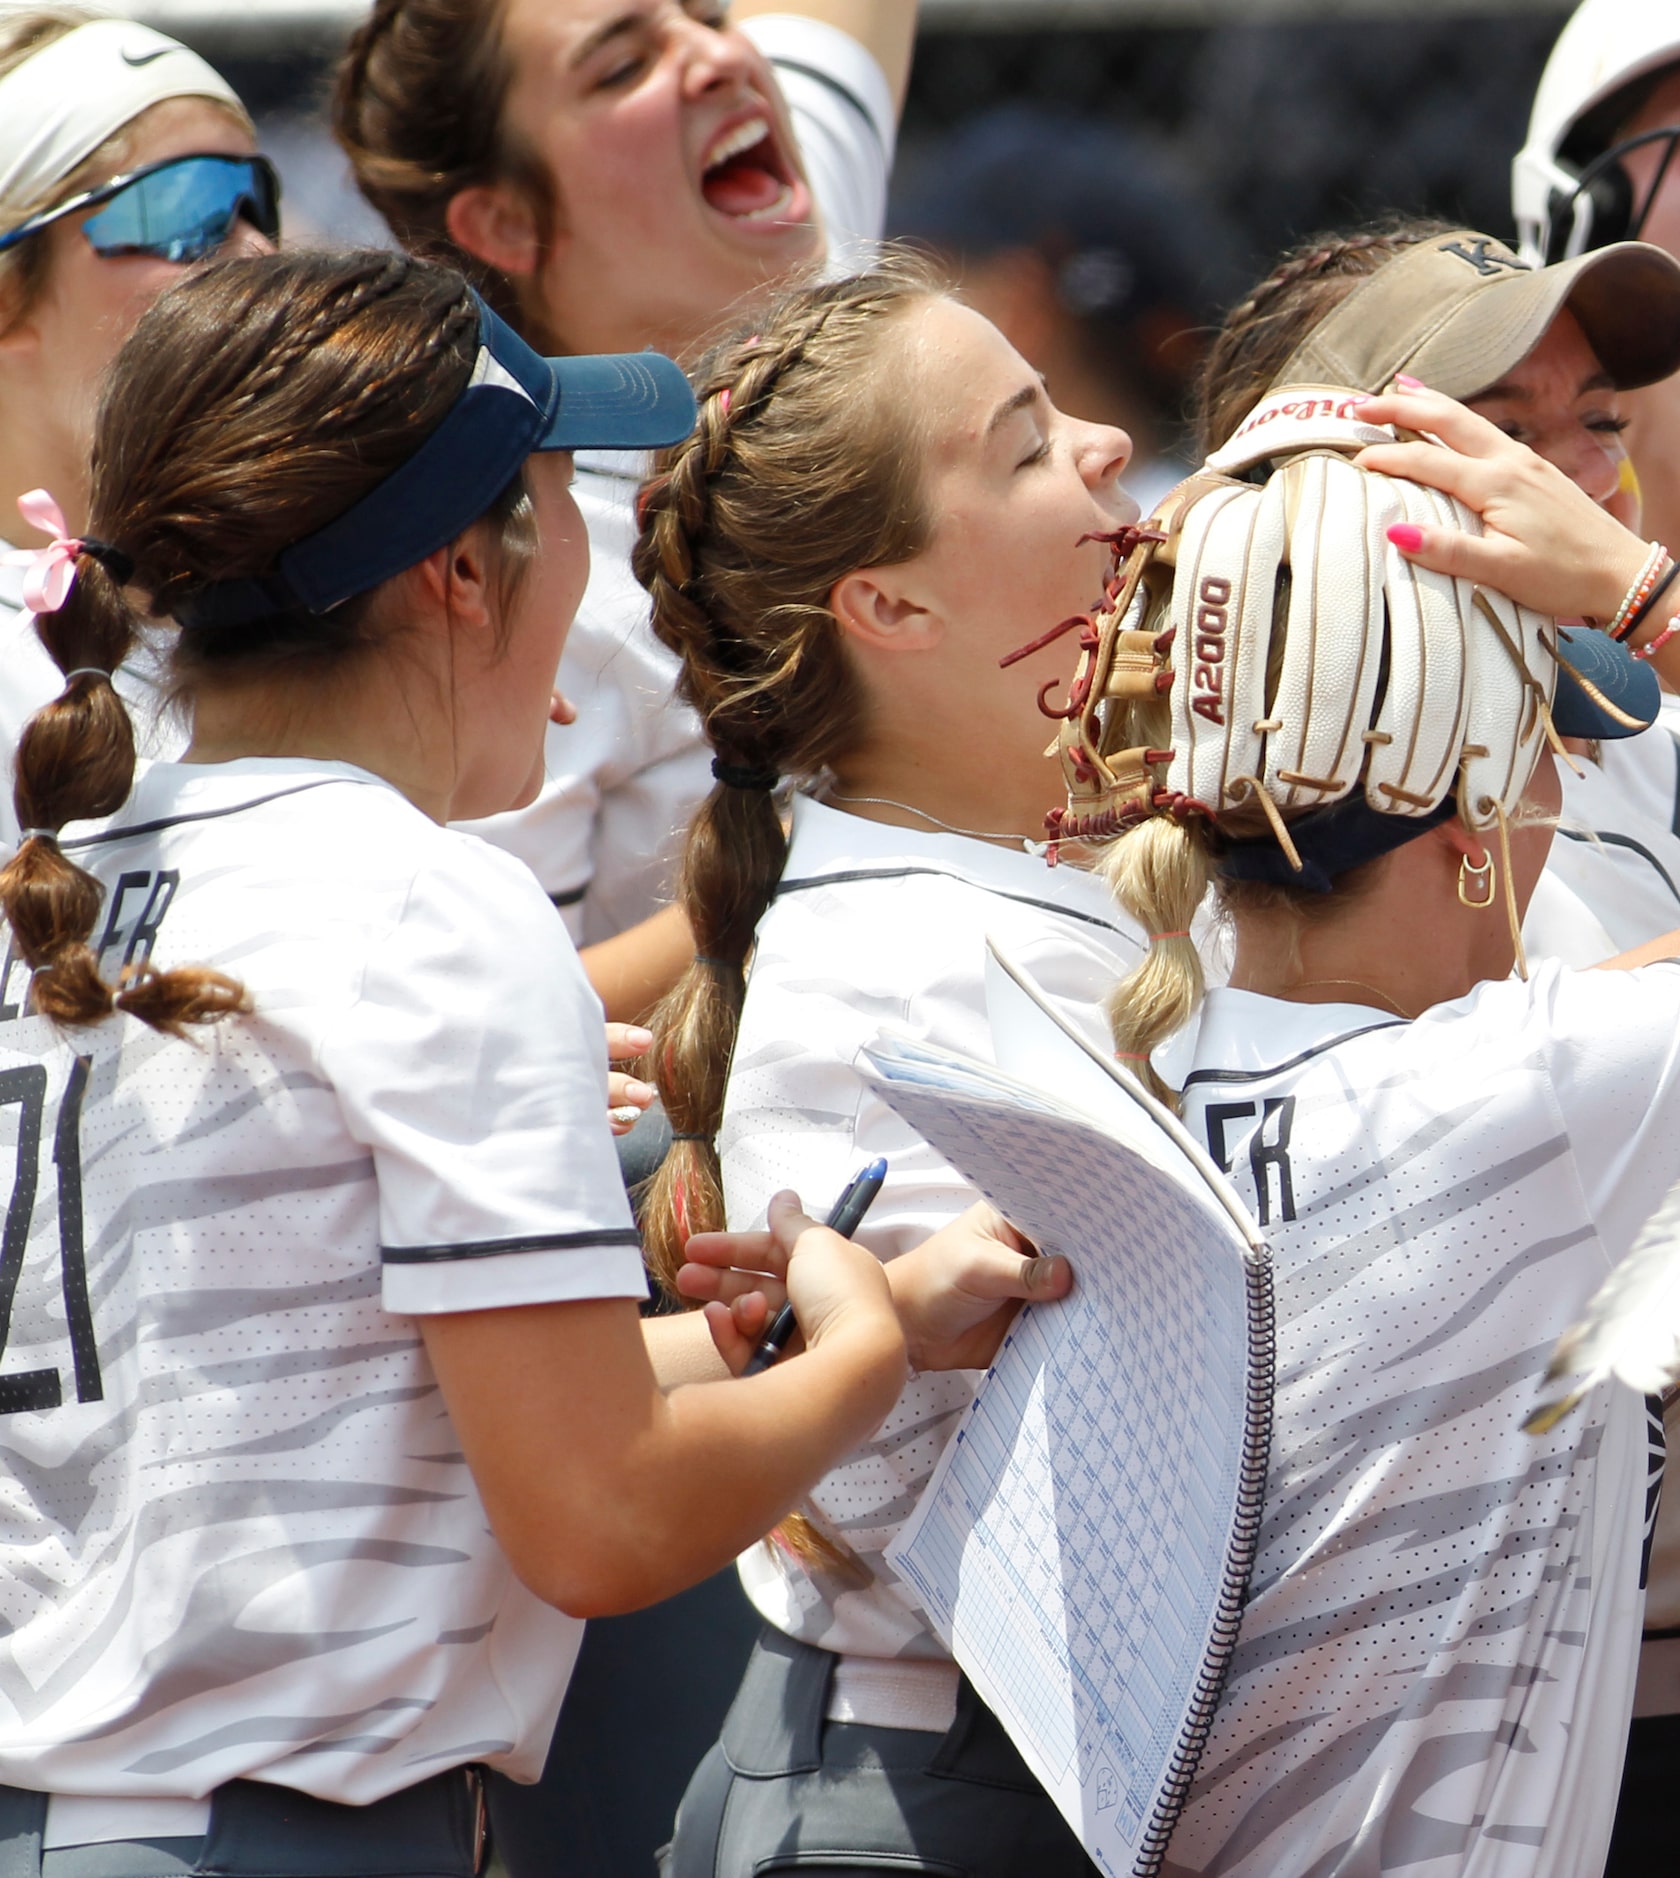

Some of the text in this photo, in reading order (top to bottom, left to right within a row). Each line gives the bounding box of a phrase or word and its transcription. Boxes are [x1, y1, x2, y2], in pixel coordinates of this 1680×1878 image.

[1438, 236, 1532, 275] K
[1192, 576, 1231, 726] A2000
[0, 1054, 103, 1414] 21
